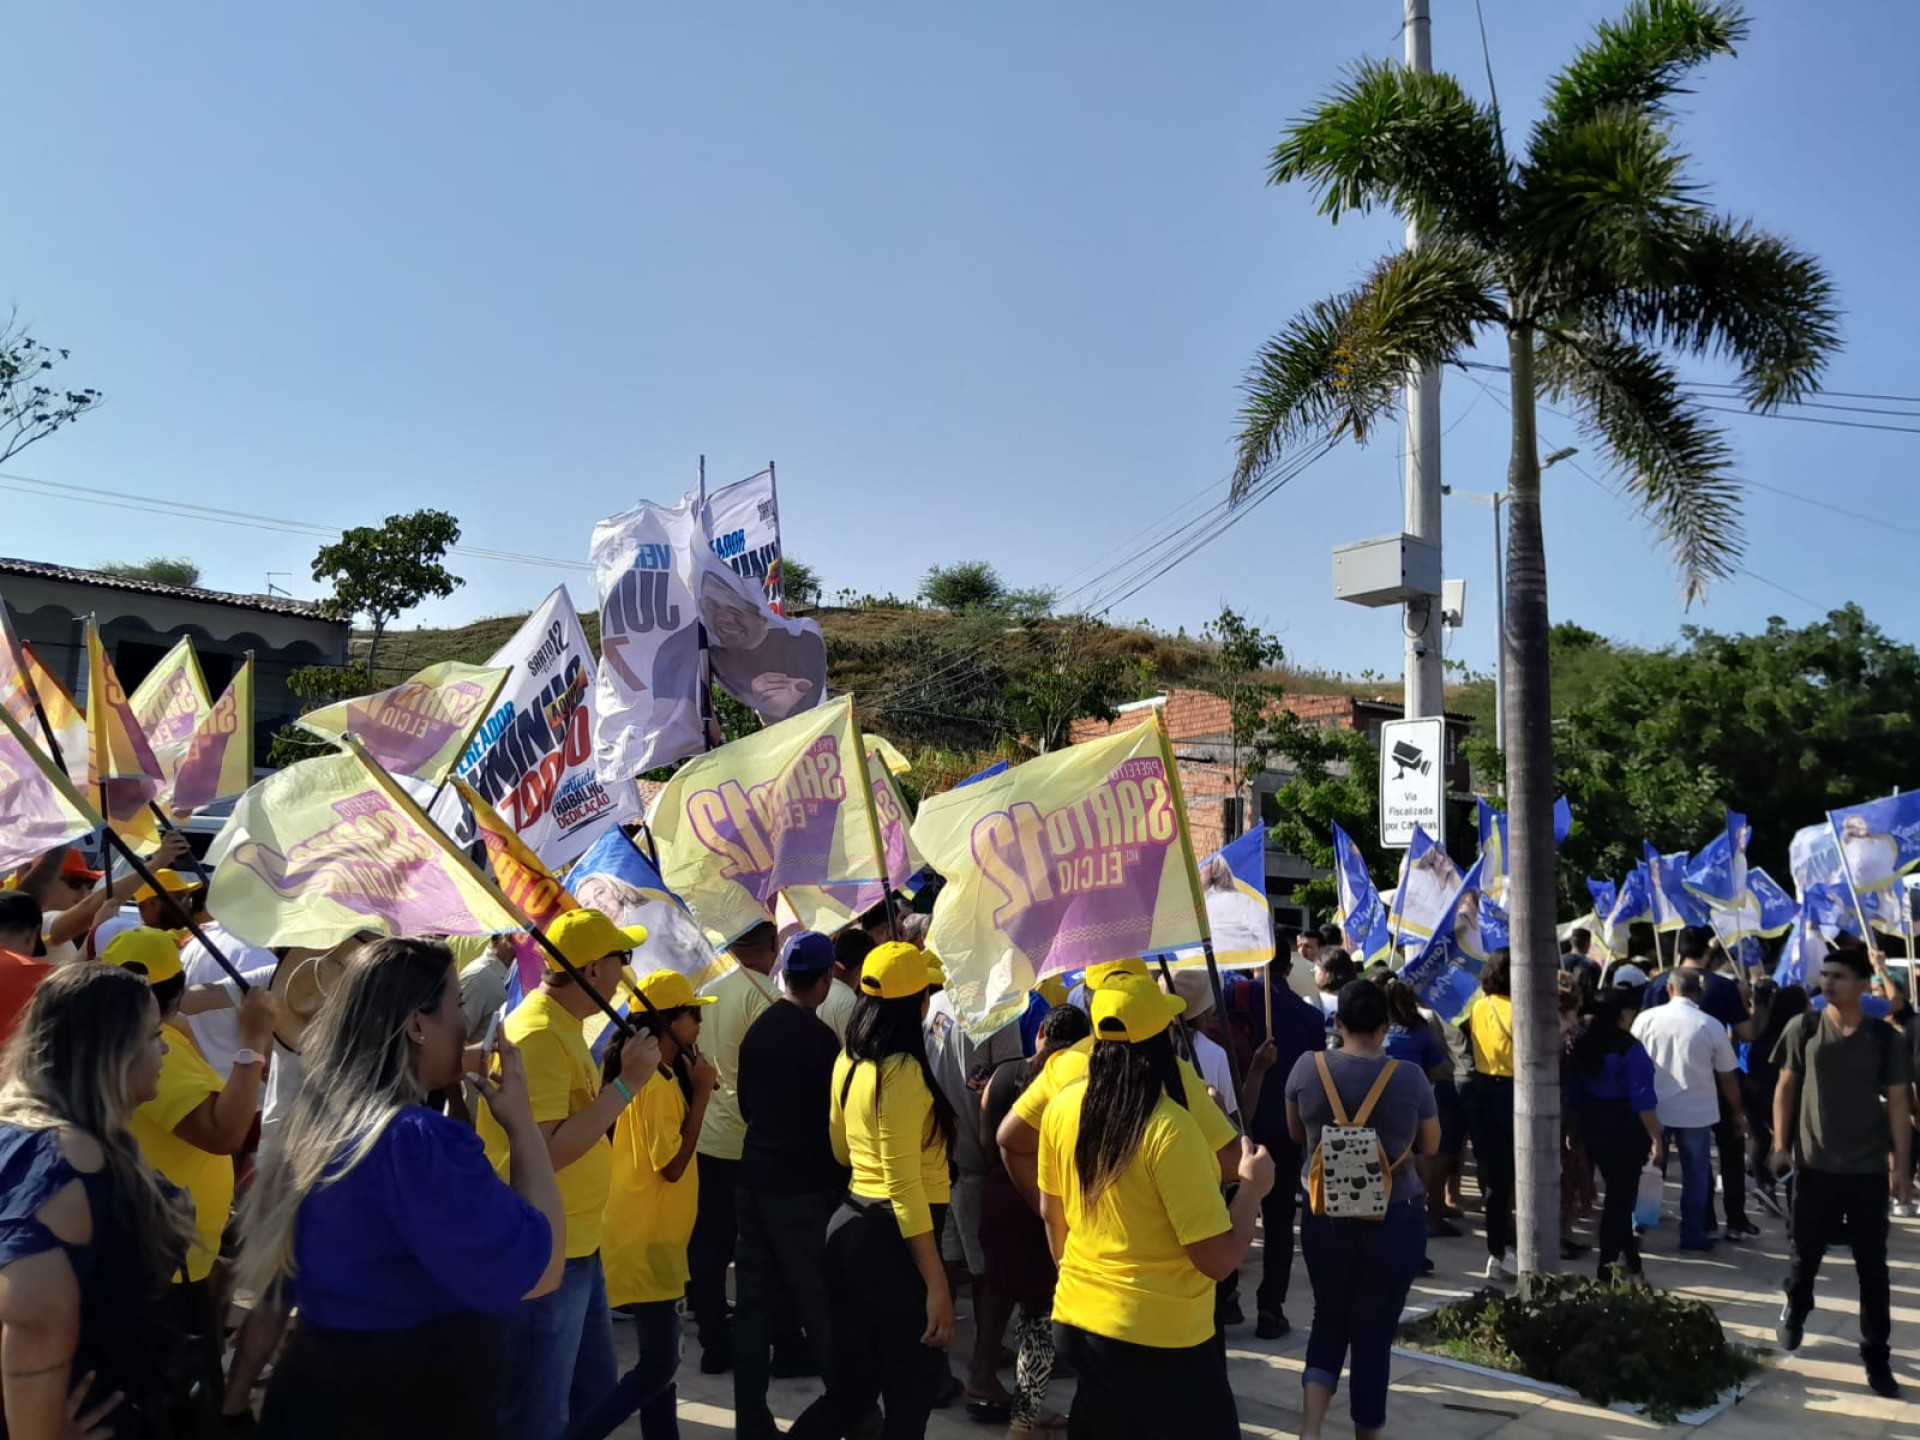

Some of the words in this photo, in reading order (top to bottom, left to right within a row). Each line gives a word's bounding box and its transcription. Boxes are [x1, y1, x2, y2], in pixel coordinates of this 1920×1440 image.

[457, 700, 517, 775] EREADOR
[1404, 792, 1418, 801] Via
[557, 792, 611, 830] DEDICAÇÃO
[1389, 806, 1433, 816] Fiscalizada
[1386, 822, 1398, 832] por
